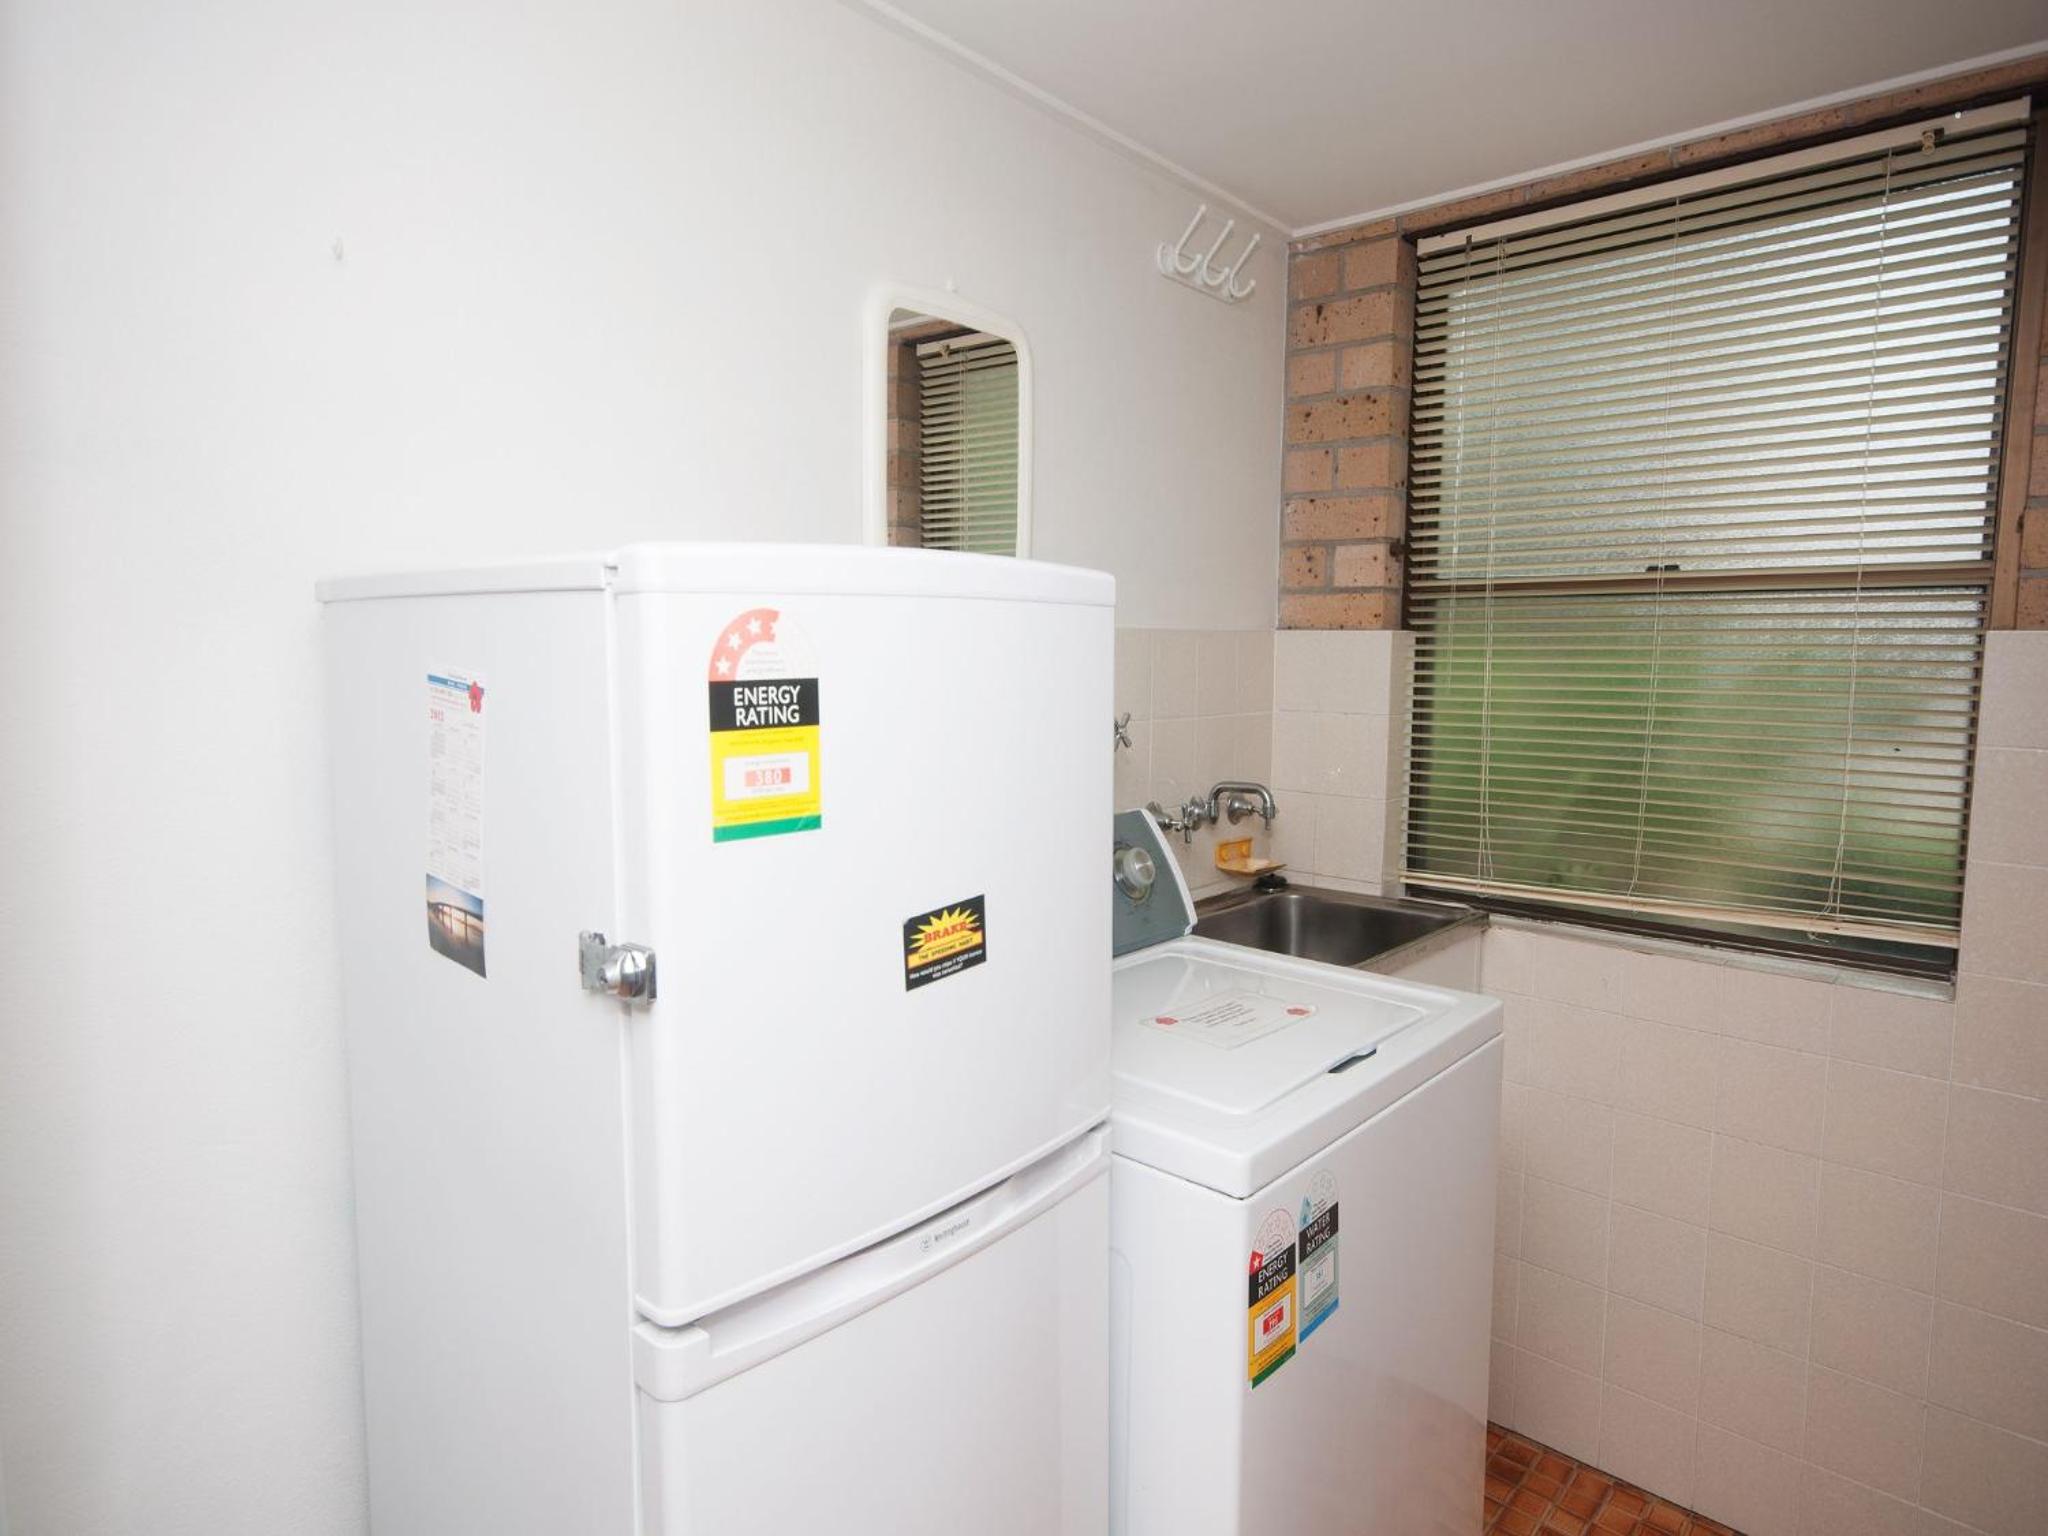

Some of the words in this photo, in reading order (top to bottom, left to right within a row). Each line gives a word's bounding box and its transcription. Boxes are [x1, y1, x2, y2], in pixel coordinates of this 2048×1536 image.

[734, 685, 800, 706] ENERGY
[735, 705, 800, 727] RATING
[754, 768, 782, 786] 380
[924, 922, 967, 944] BRAKE
[1306, 1211, 1331, 1240] WATER
[1306, 1229, 1331, 1255] RATING
[1258, 1250, 1289, 1284] ENERGY
[1258, 1272, 1289, 1300] RATING
